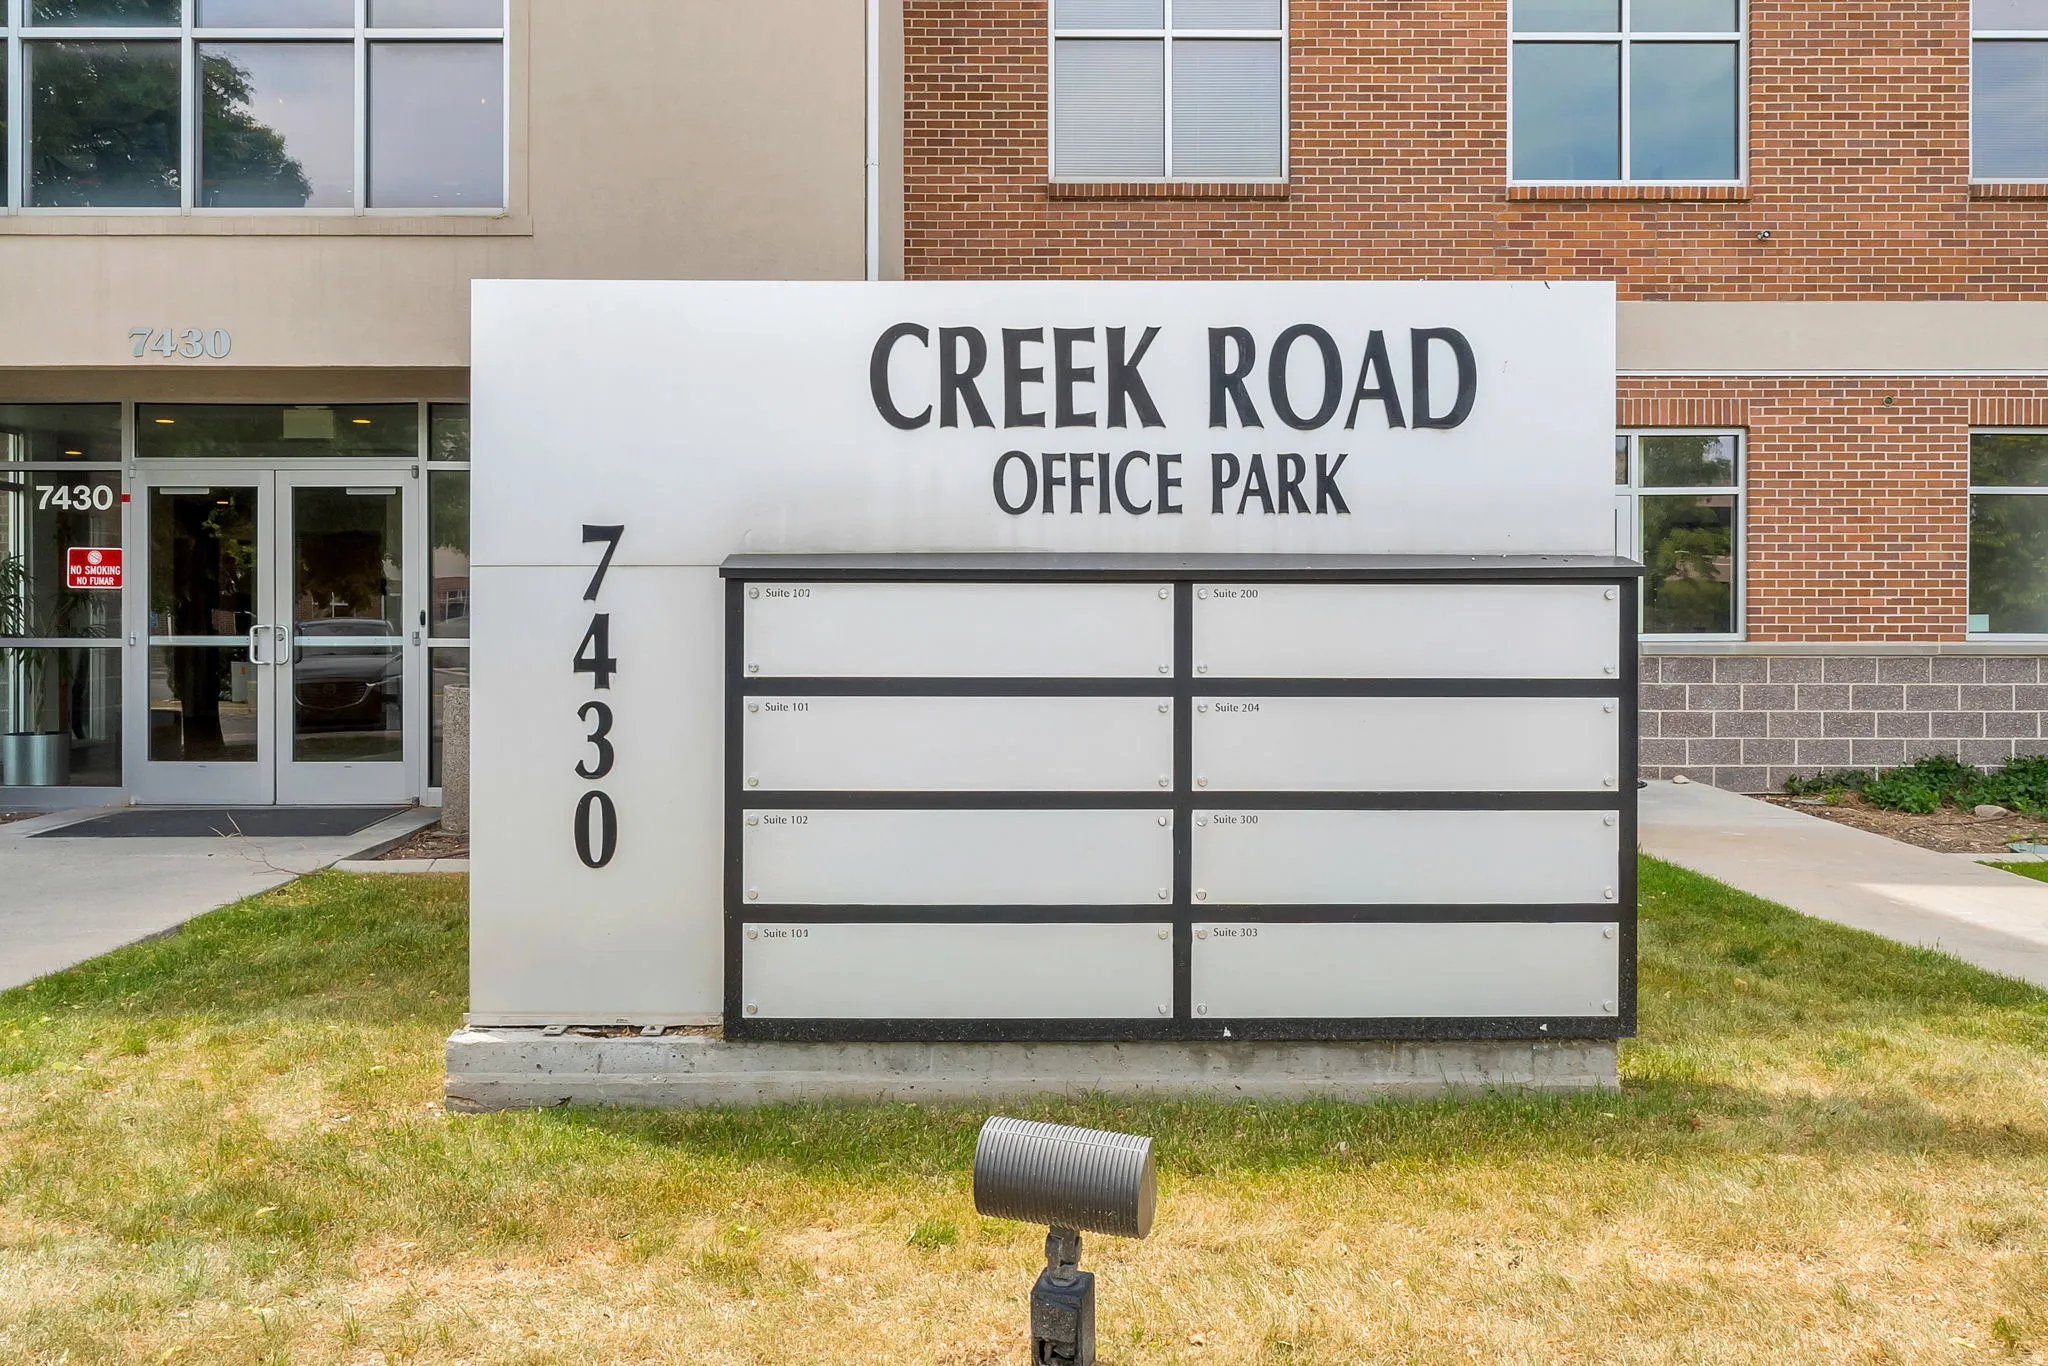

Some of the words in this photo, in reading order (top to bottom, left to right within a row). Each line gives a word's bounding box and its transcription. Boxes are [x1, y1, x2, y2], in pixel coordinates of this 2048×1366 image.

[128, 327, 232, 359] 7430
[870, 323, 1165, 430] CREEK
[1208, 324, 1476, 430] ROAD
[994, 451, 1182, 515] OFFICE
[1212, 453, 1350, 515] PARK
[35, 484, 114, 511] 7430
[70, 565, 82, 575] NO
[84, 565, 121, 575] SMOKING
[76, 577, 88, 585] NO
[89, 577, 114, 585] FUMAR
[765, 588, 790, 598] Suite
[1213, 588, 1237, 598] Suite
[1240, 589, 1259, 599] 200
[765, 702, 789, 711] Suite
[792, 702, 809, 711] 101
[1215, 702, 1239, 712] Suite
[1241, 703, 1260, 712] 204
[763, 814, 787, 824] Suite
[791, 815, 808, 824] 102
[1213, 814, 1237, 824] Suite
[1240, 815, 1259, 824] 300
[763, 928, 787, 938] Suite
[1213, 927, 1237, 937] Suite
[1240, 928, 1258, 937] 303
